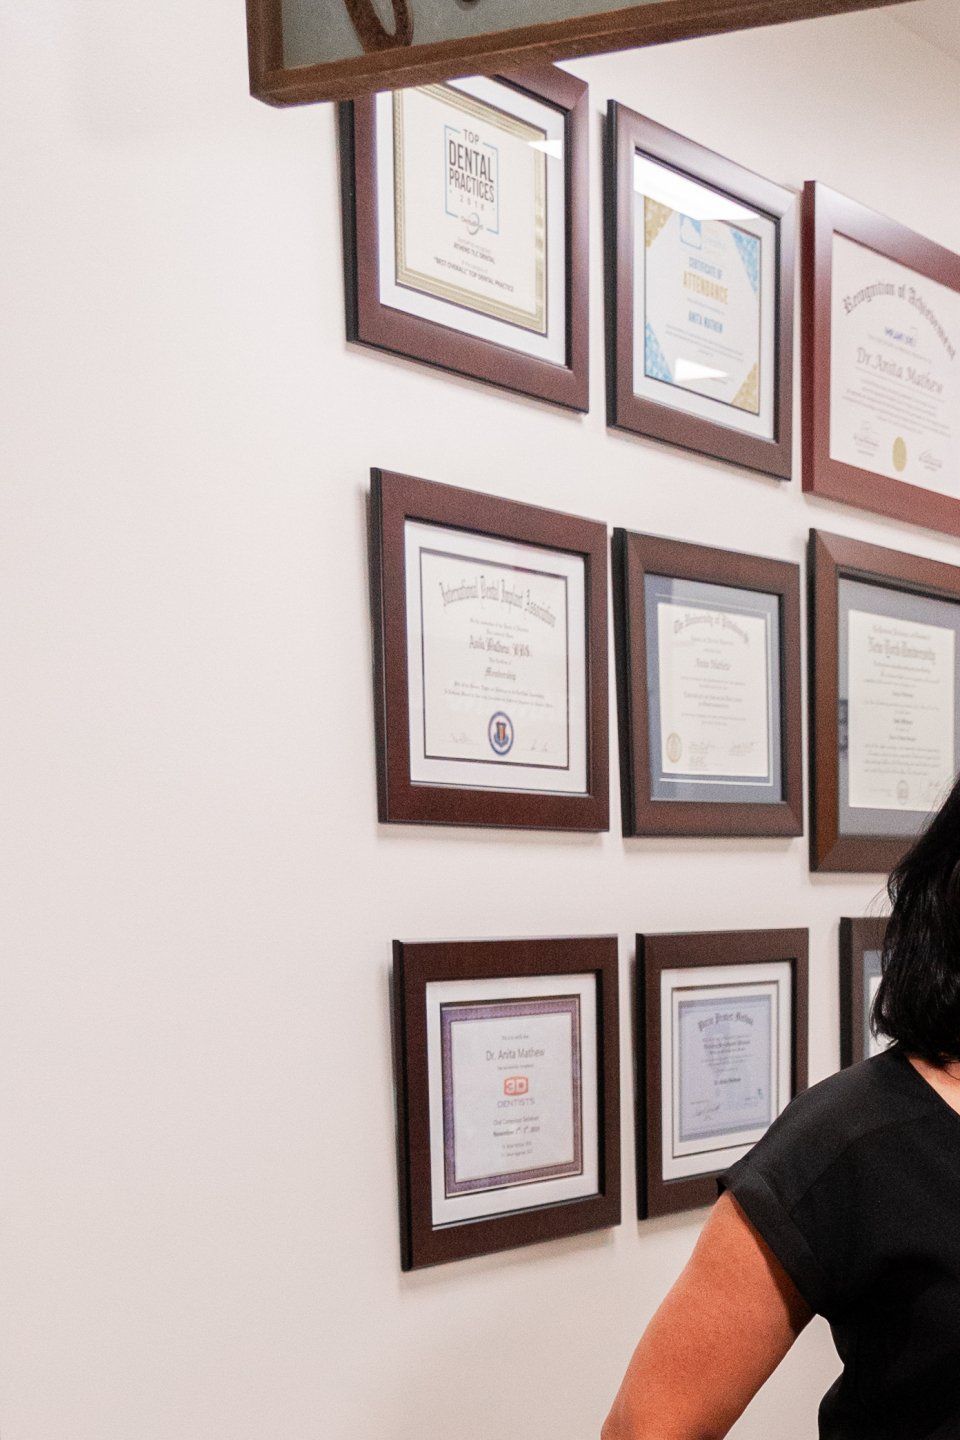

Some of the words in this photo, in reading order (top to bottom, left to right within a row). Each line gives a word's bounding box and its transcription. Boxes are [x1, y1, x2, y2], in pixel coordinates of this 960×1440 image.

[463, 128, 480, 145] TOP
[448, 139, 494, 184] DENTAL
[448, 167, 495, 204] PRACTICES
[486, 1050, 496, 1061] Dr.
[498, 1048, 516, 1060] Anita
[518, 1047, 545, 1059] Mathew
[504, 1077, 528, 1095] 3D
[497, 1097, 535, 1108] DENTISTS
